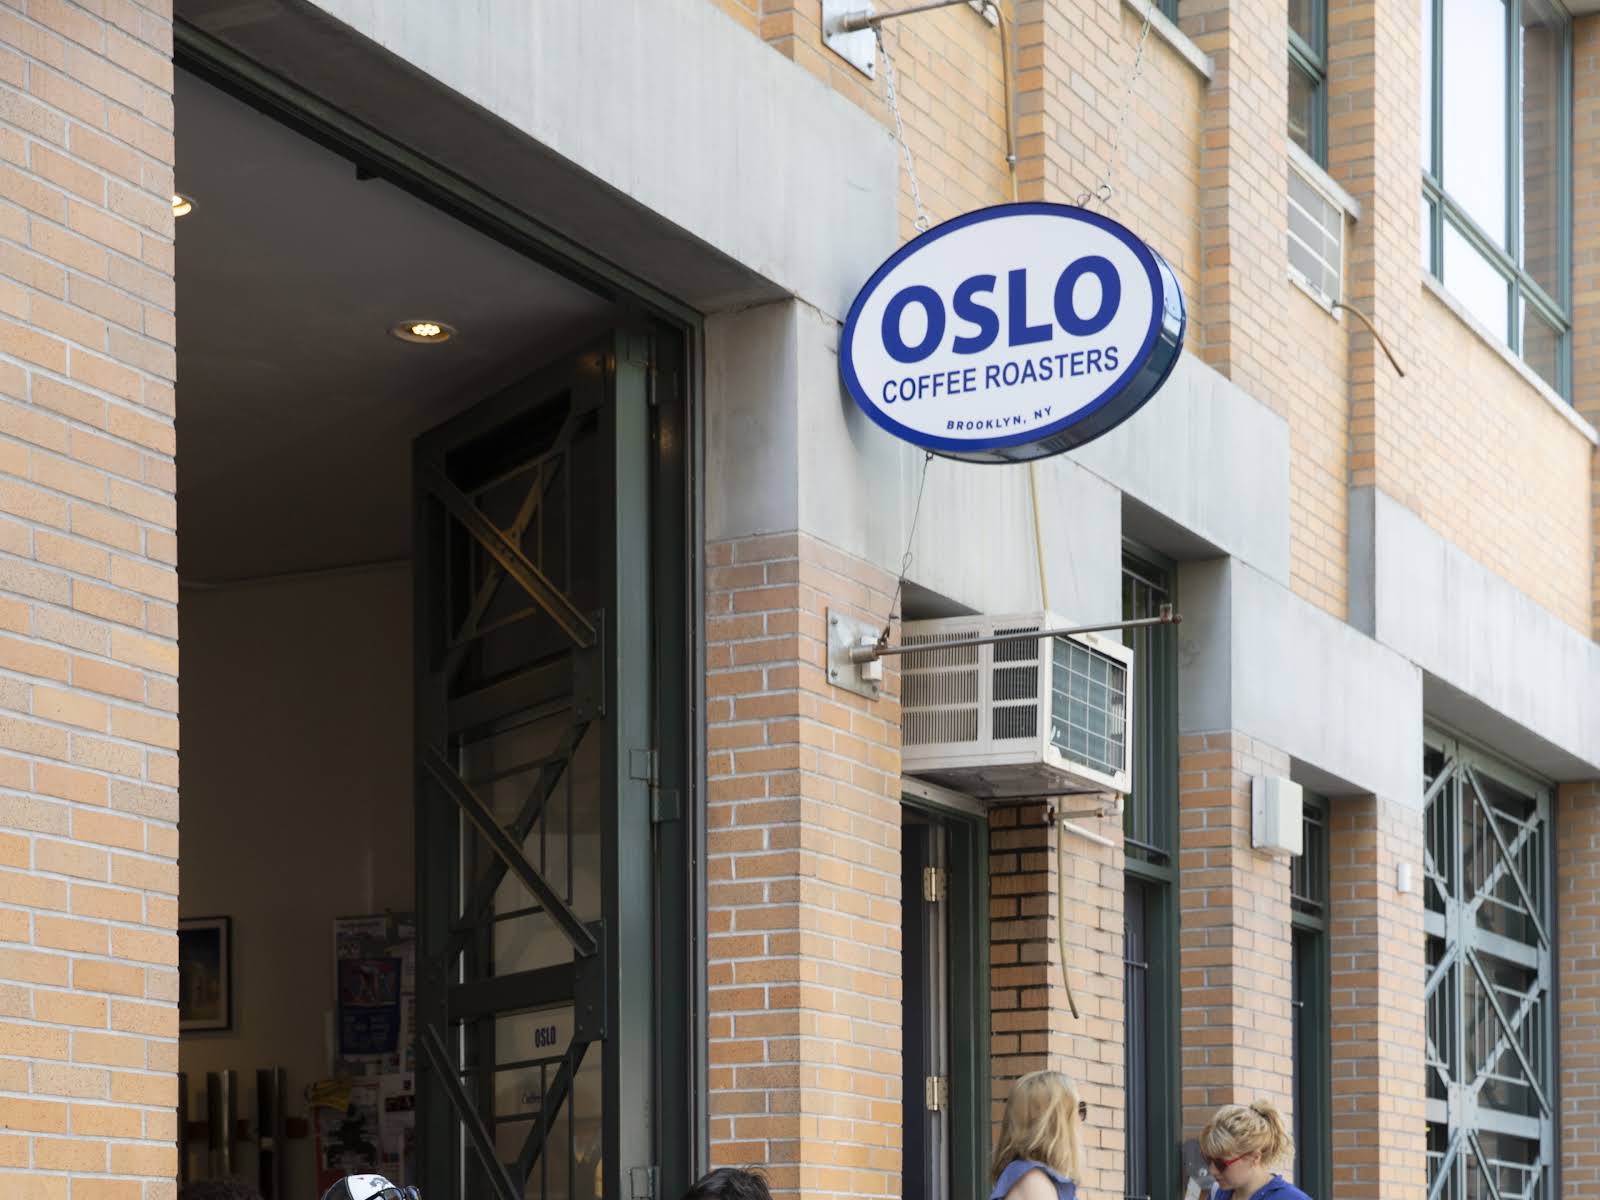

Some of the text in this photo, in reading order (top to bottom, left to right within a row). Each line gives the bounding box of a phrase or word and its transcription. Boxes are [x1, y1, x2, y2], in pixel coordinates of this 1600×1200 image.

[880, 255, 1122, 364] OSLO
[882, 345, 1119, 404] COFFEE ROASTERS
[946, 406, 1053, 431] BROOKLYN, NY
[534, 1025, 557, 1048] OSLO
